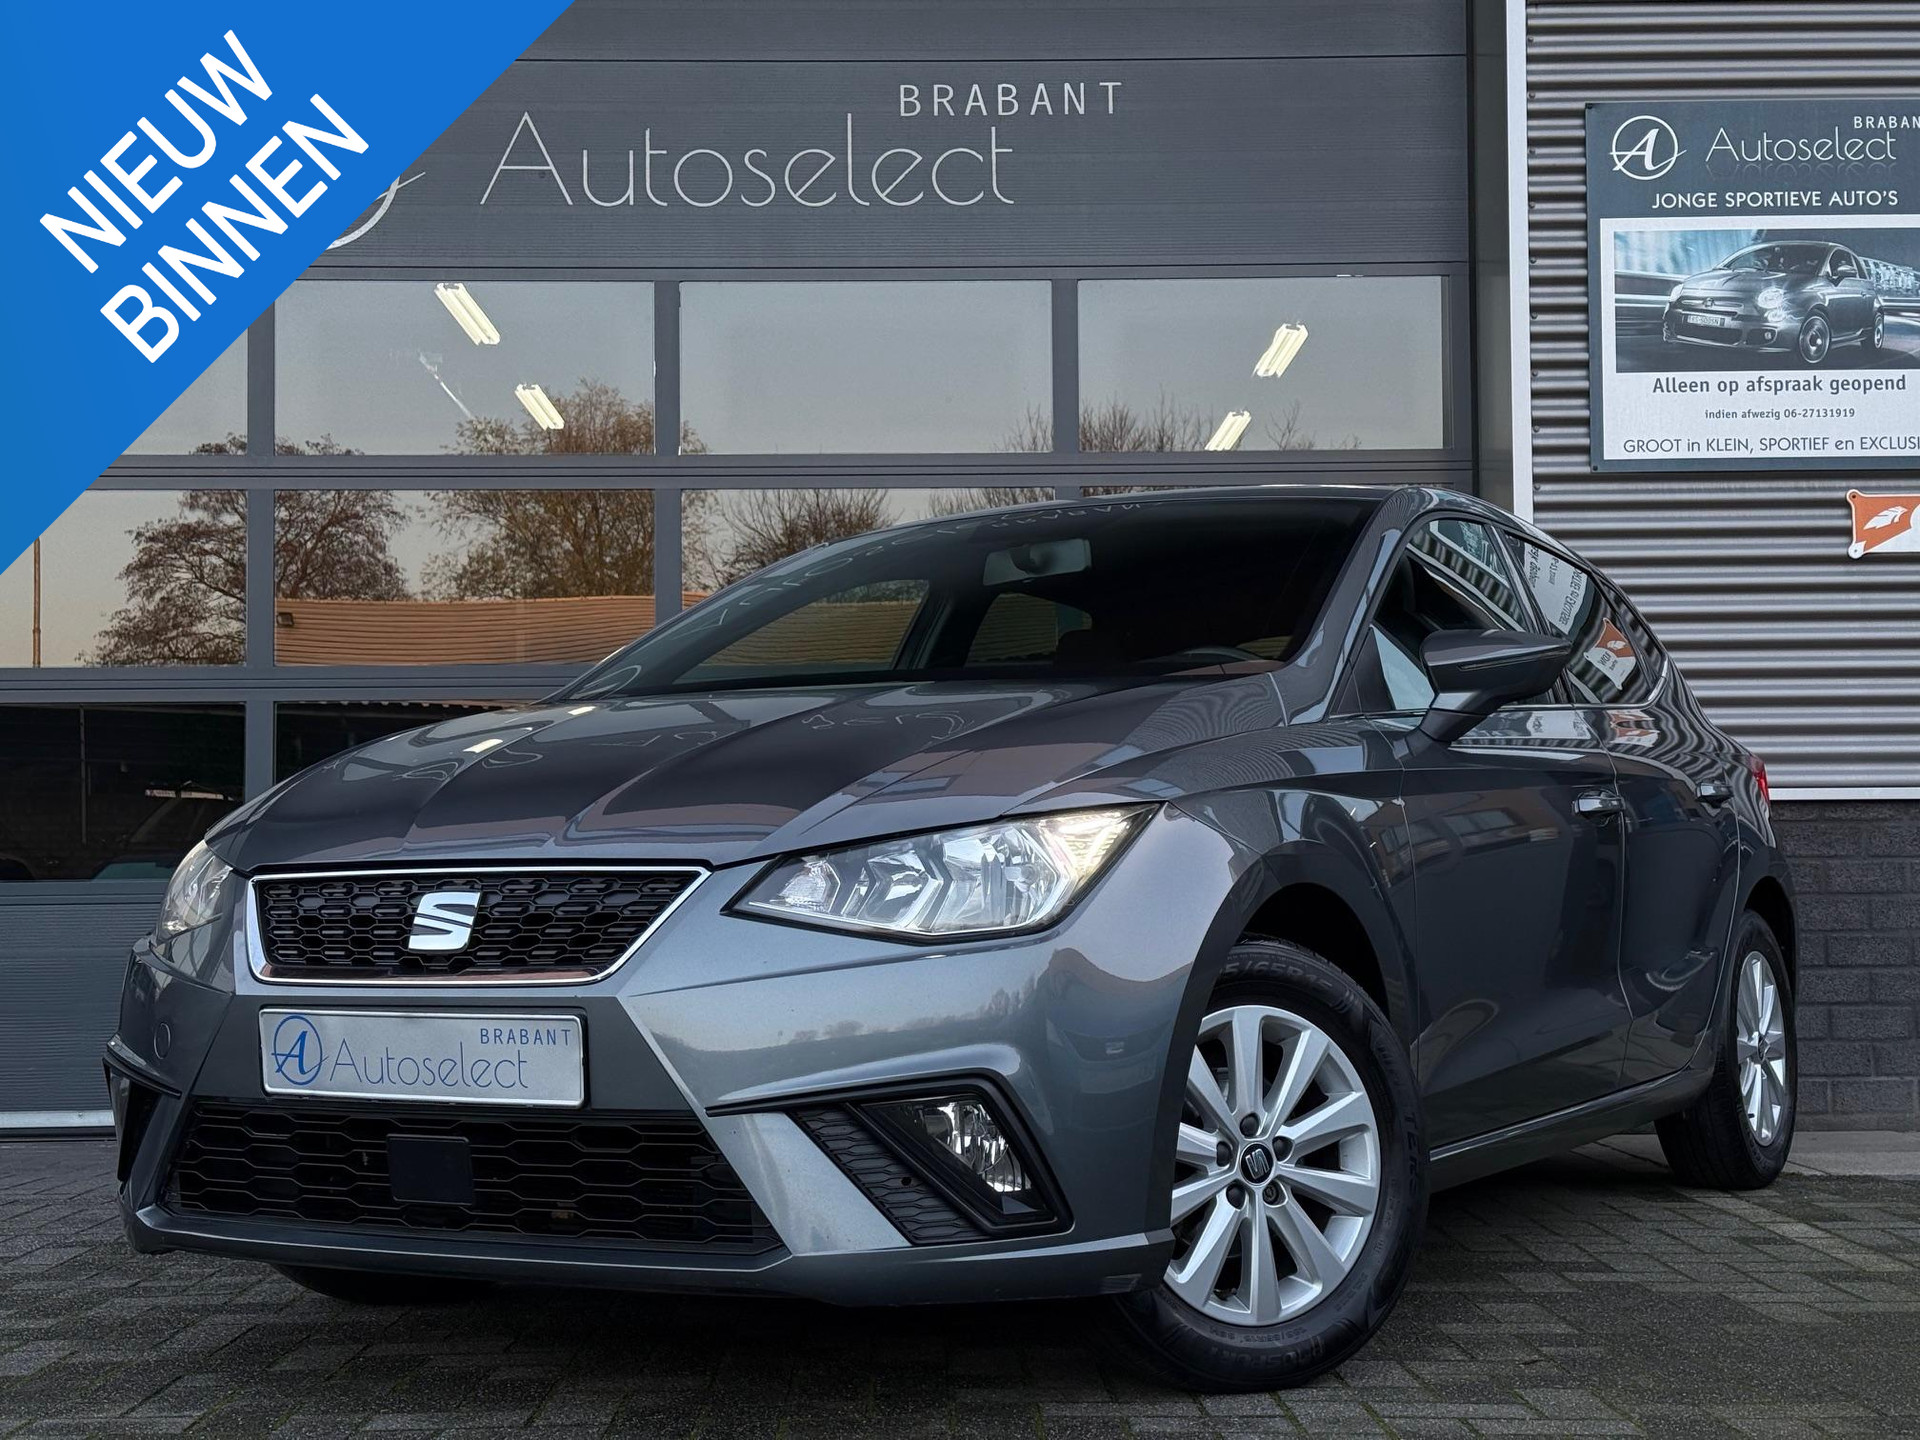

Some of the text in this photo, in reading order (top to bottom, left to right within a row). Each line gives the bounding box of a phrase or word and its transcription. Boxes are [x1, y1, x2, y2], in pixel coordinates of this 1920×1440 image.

[900, 82, 1122, 117] BRABANT
[1705, 126, 1897, 162] Autoselect
[480, 111, 1015, 207] Autoselect
[1652, 190, 1898, 209] JONGE SPORTIEVE AUTO'S
[1652, 374, 1906, 396] Alleen op afspraak geopend
[1705, 407, 1855, 421] indien afwezig 06-27131919
[1623, 439, 1682, 453] GROOT
[1687, 439, 1701, 452] in
[1706, 438, 1754, 454] KLEIN,
[1759, 436, 1829, 452] SPORTIEF
[1835, 439, 1855, 451] en
[479, 1028, 572, 1047] BRABANT
[329, 1038, 529, 1089] Autoselect
